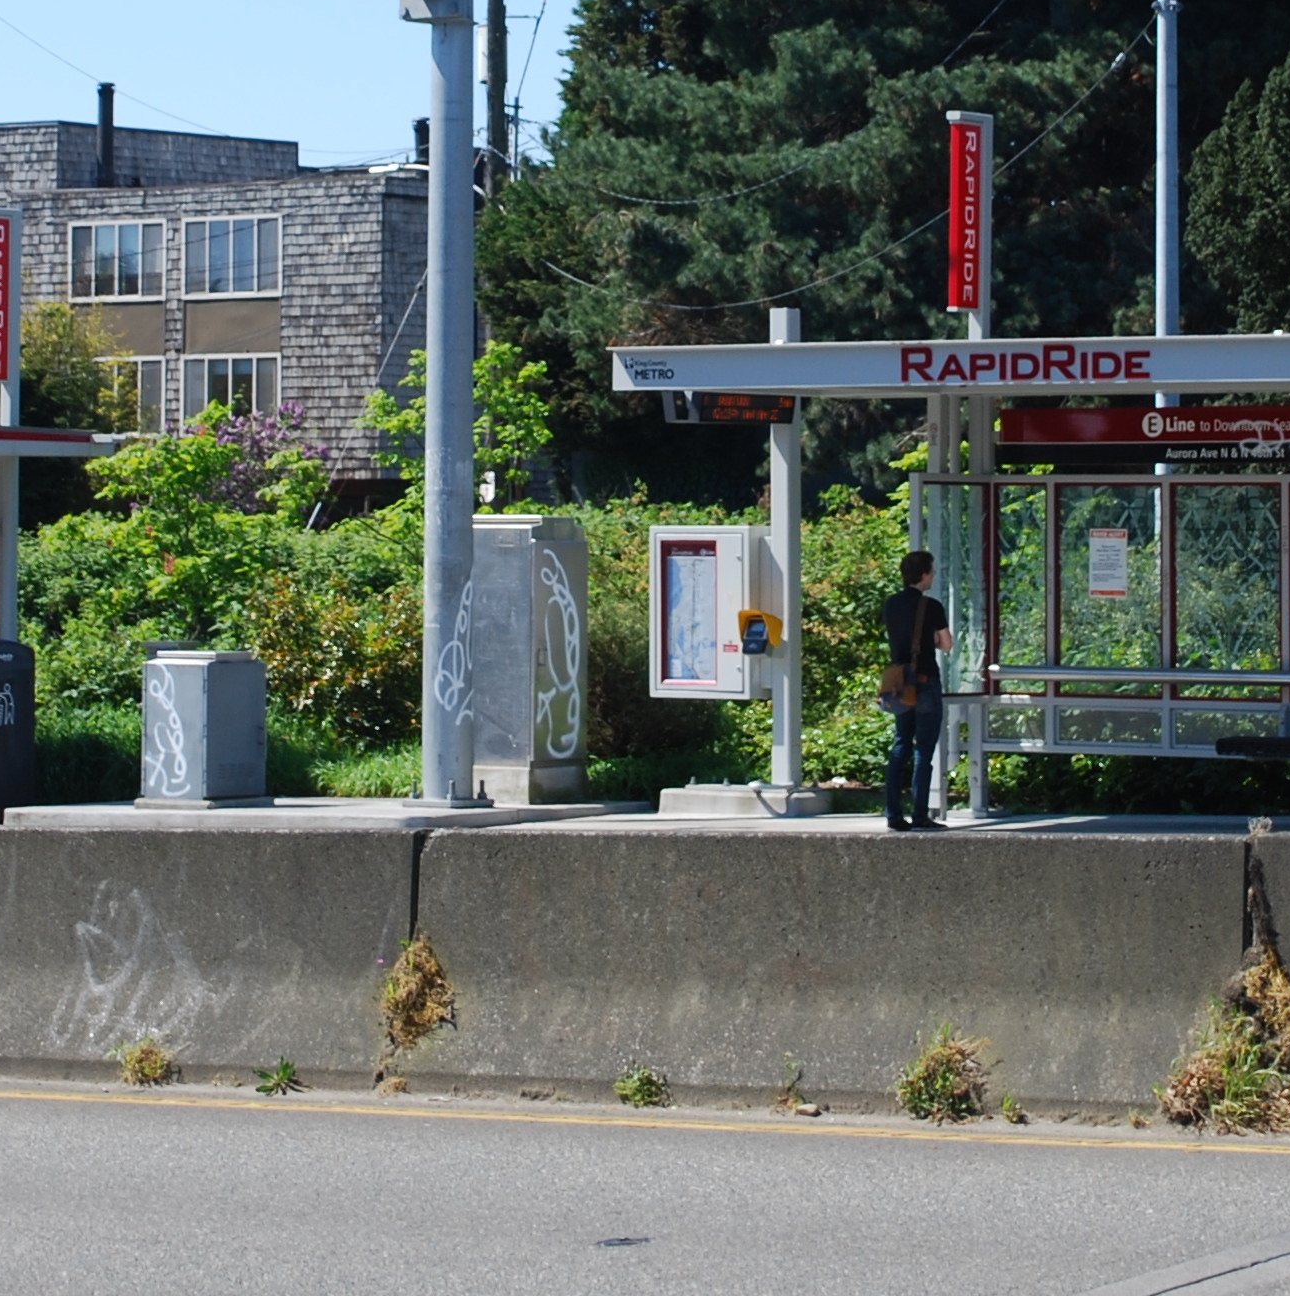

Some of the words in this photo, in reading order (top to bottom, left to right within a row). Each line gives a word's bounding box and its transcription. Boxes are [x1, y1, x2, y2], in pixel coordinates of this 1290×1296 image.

[634, 368, 675, 380] METRO
[1166, 416, 1196, 432] Line
[1199, 420, 1211, 432] to
[1214, 419, 1271, 432] Downtown
[1165, 447, 1198, 459] Aurora
[1200, 447, 1219, 459] Ave
[1220, 447, 1228, 458] N
[1230, 447, 1238, 458] &
[1275, 447, 1285, 458] St
